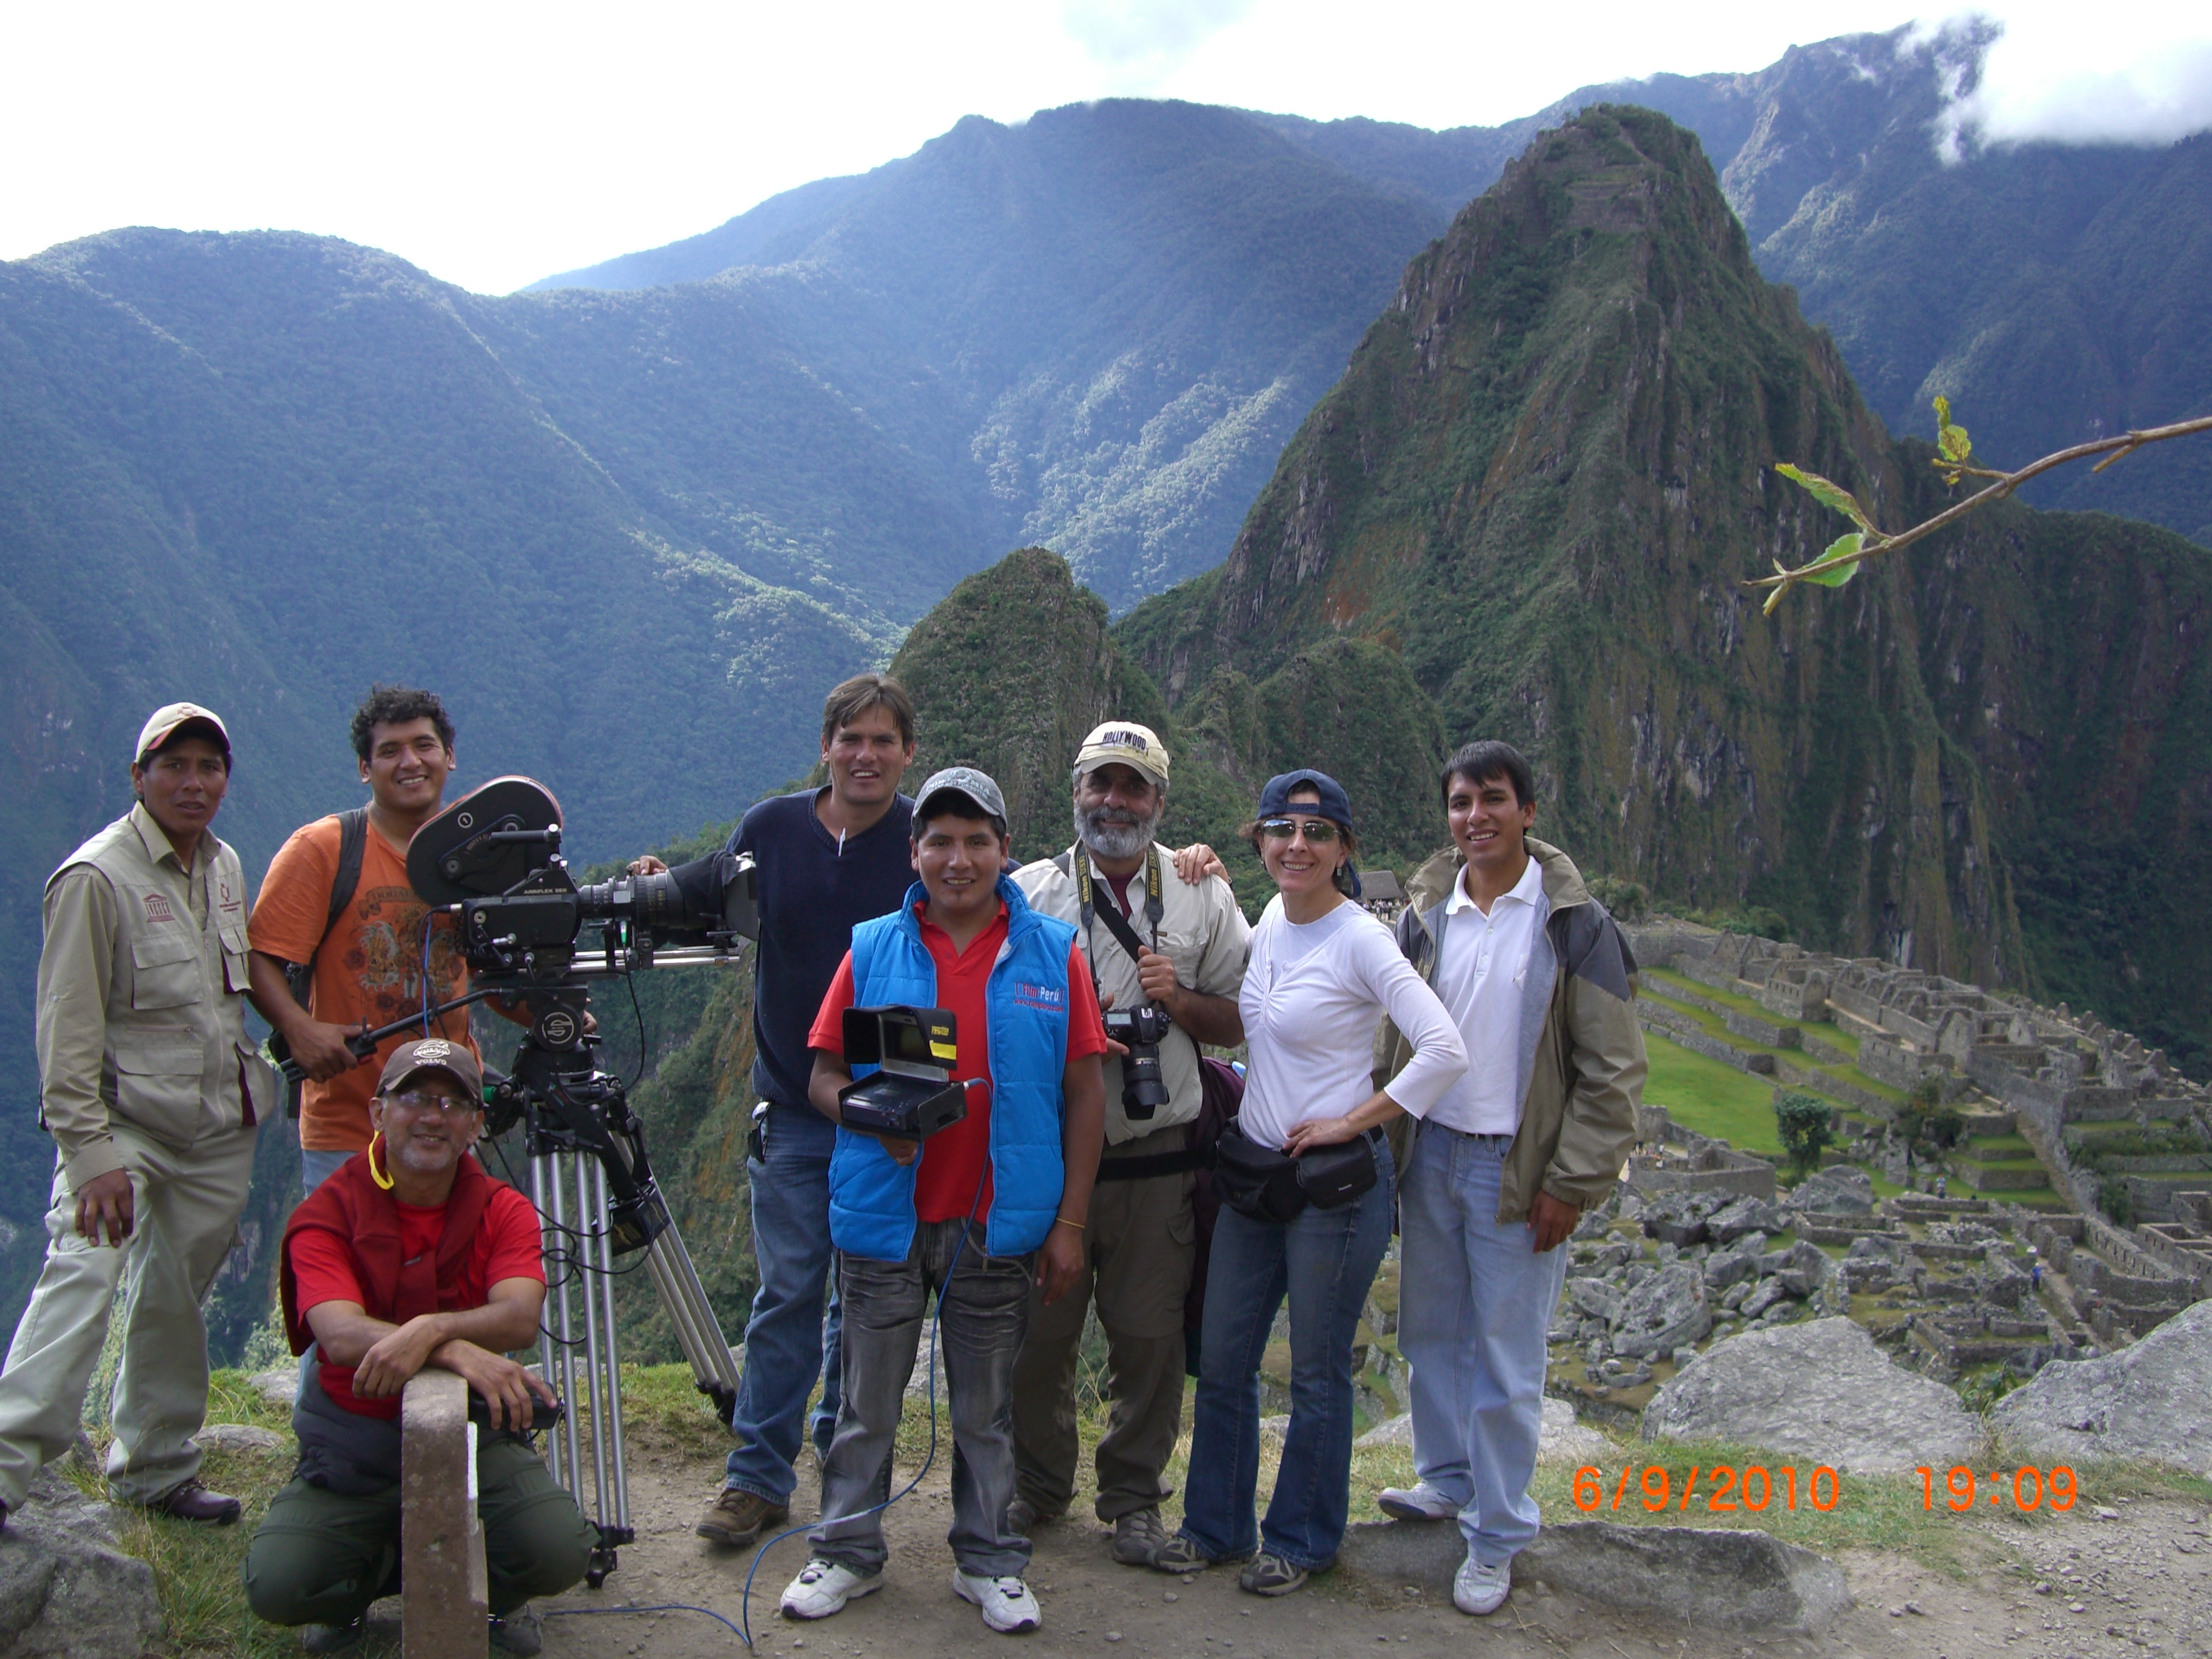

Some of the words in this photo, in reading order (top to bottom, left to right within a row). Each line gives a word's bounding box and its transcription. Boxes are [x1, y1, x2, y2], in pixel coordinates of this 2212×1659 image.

[1102, 730, 1147, 751] HOLLYWOOD
[1082, 875, 1090, 903] Nikon
[1150, 868, 1159, 897] Nikon
[1022, 983, 1038, 998] Film
[1040, 986, 1059, 1002] Perú
